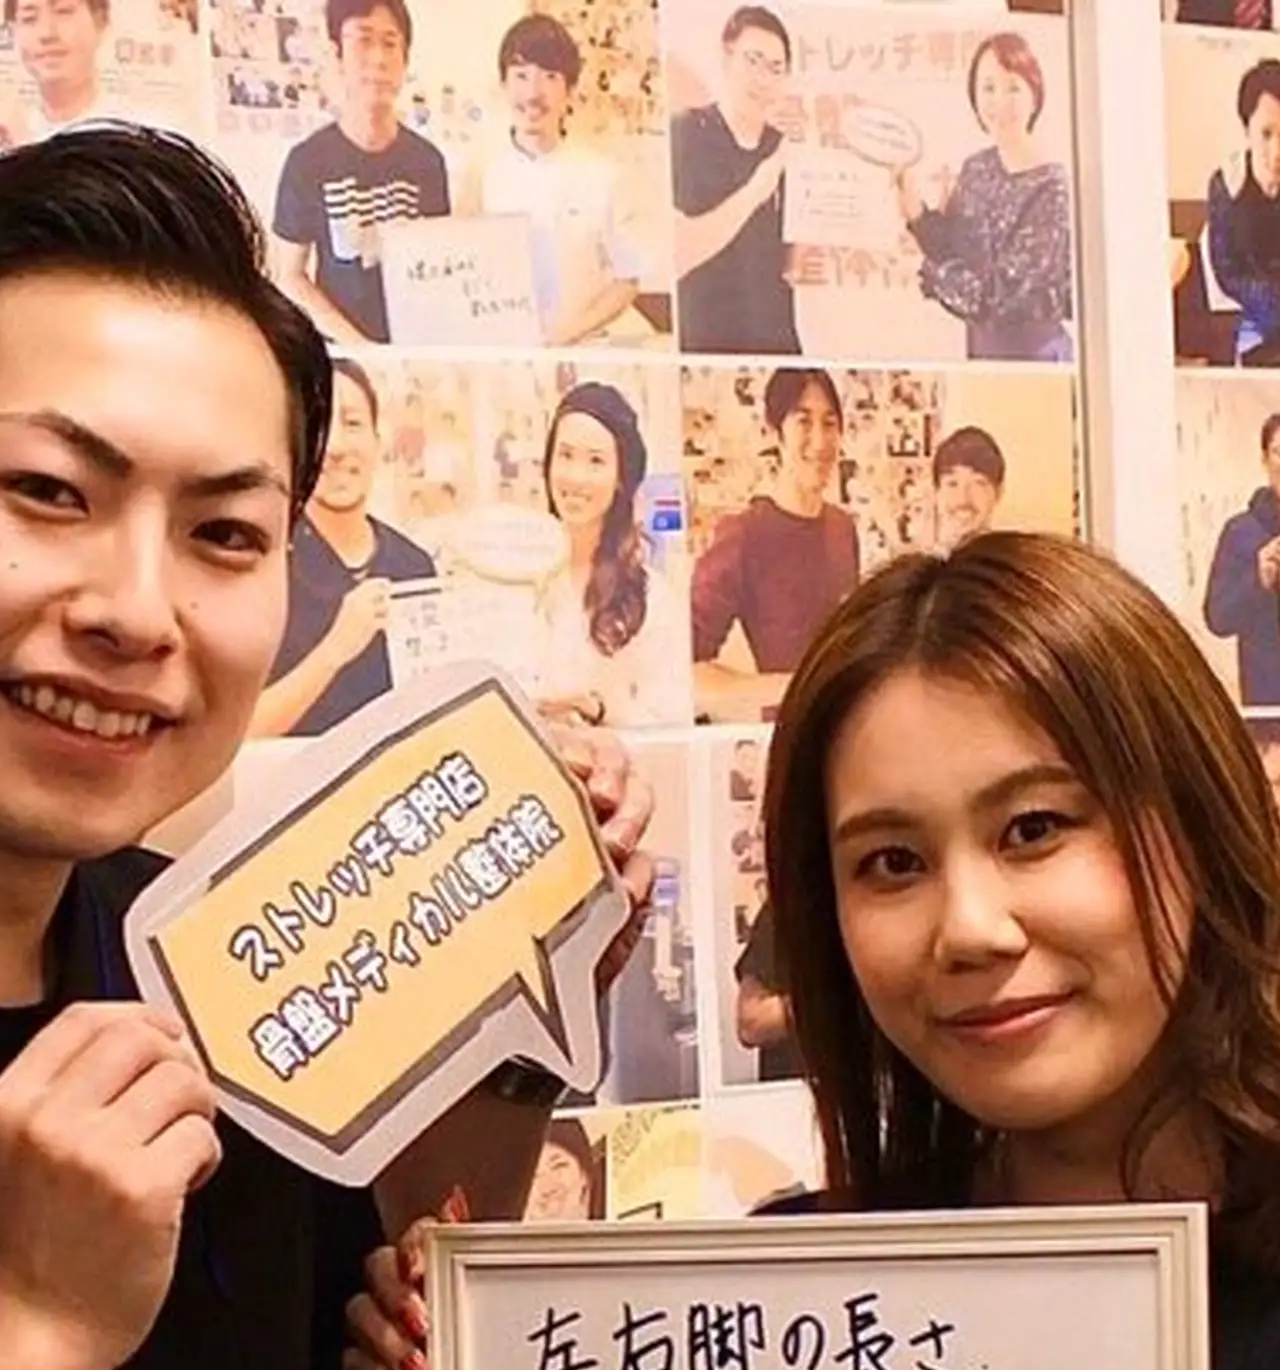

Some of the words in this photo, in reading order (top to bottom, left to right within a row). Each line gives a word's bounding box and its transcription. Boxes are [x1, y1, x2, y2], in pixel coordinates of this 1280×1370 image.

[228, 750, 489, 982] ストレッチ専門店
